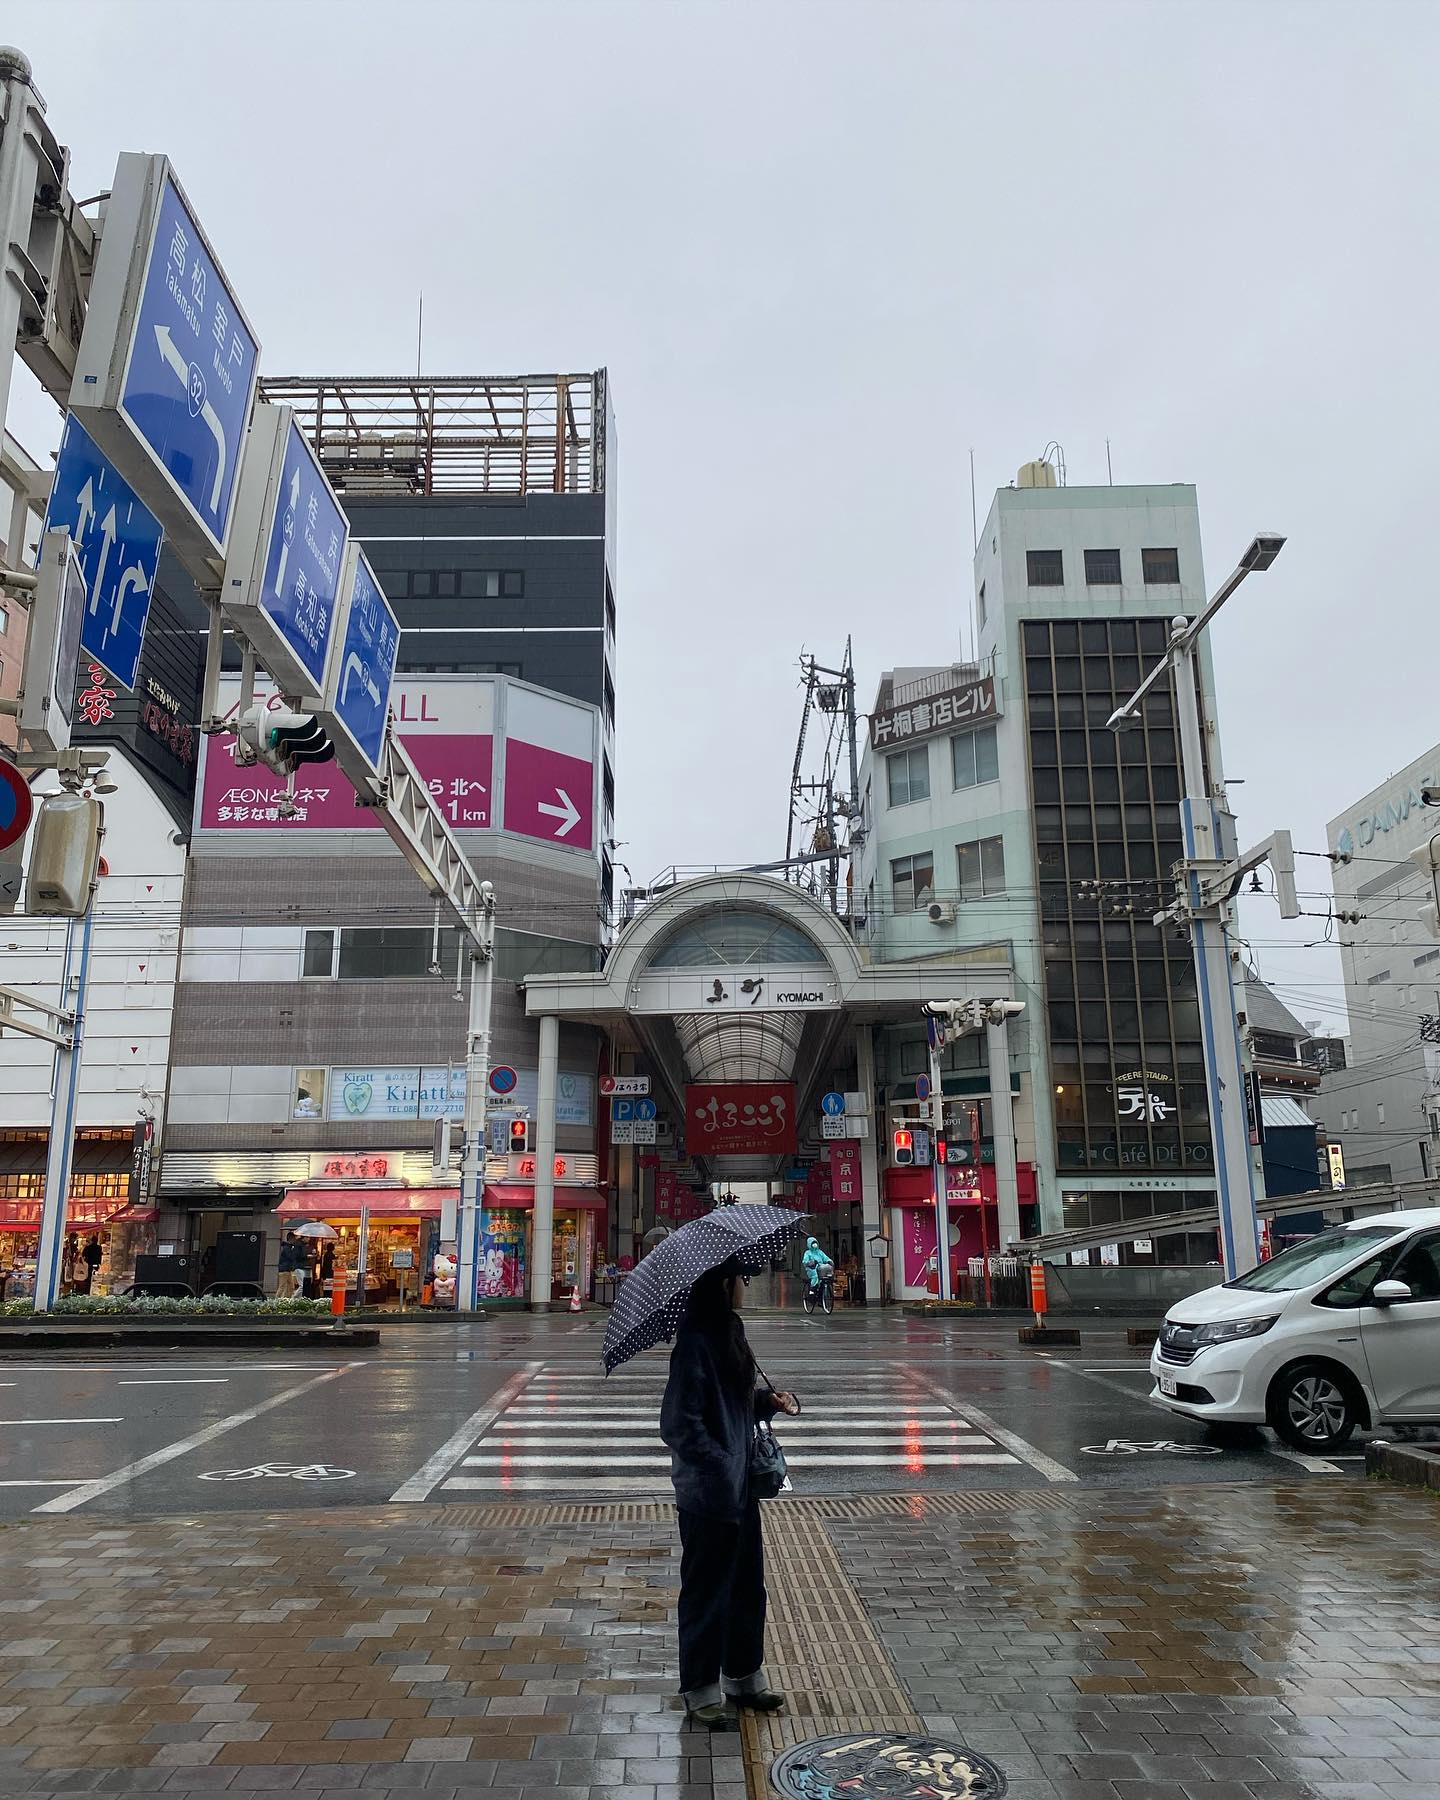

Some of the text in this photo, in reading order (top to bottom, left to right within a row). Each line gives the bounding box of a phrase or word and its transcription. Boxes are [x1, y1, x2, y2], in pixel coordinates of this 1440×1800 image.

[170, 221, 244, 366] 高松 室戸
[156, 262, 233, 394] Takamatsu Muroto
[190, 373, 202, 406] 32
[284, 519, 294, 540] 34
[294, 568, 328, 638] 高知港
[294, 608, 310, 639] Kochi
[874, 686, 991, 745] 片桐書店ビル
[217, 806, 308, 821] 多彩な専店
[777, 992, 823, 1003] KYOMACHI
[344, 1072, 374, 1082] Kiratt
[618, 1101, 630, 1119] P
[1102, 1145, 1146, 1163] Café
[840, 1162, 852, 1194] 京町
